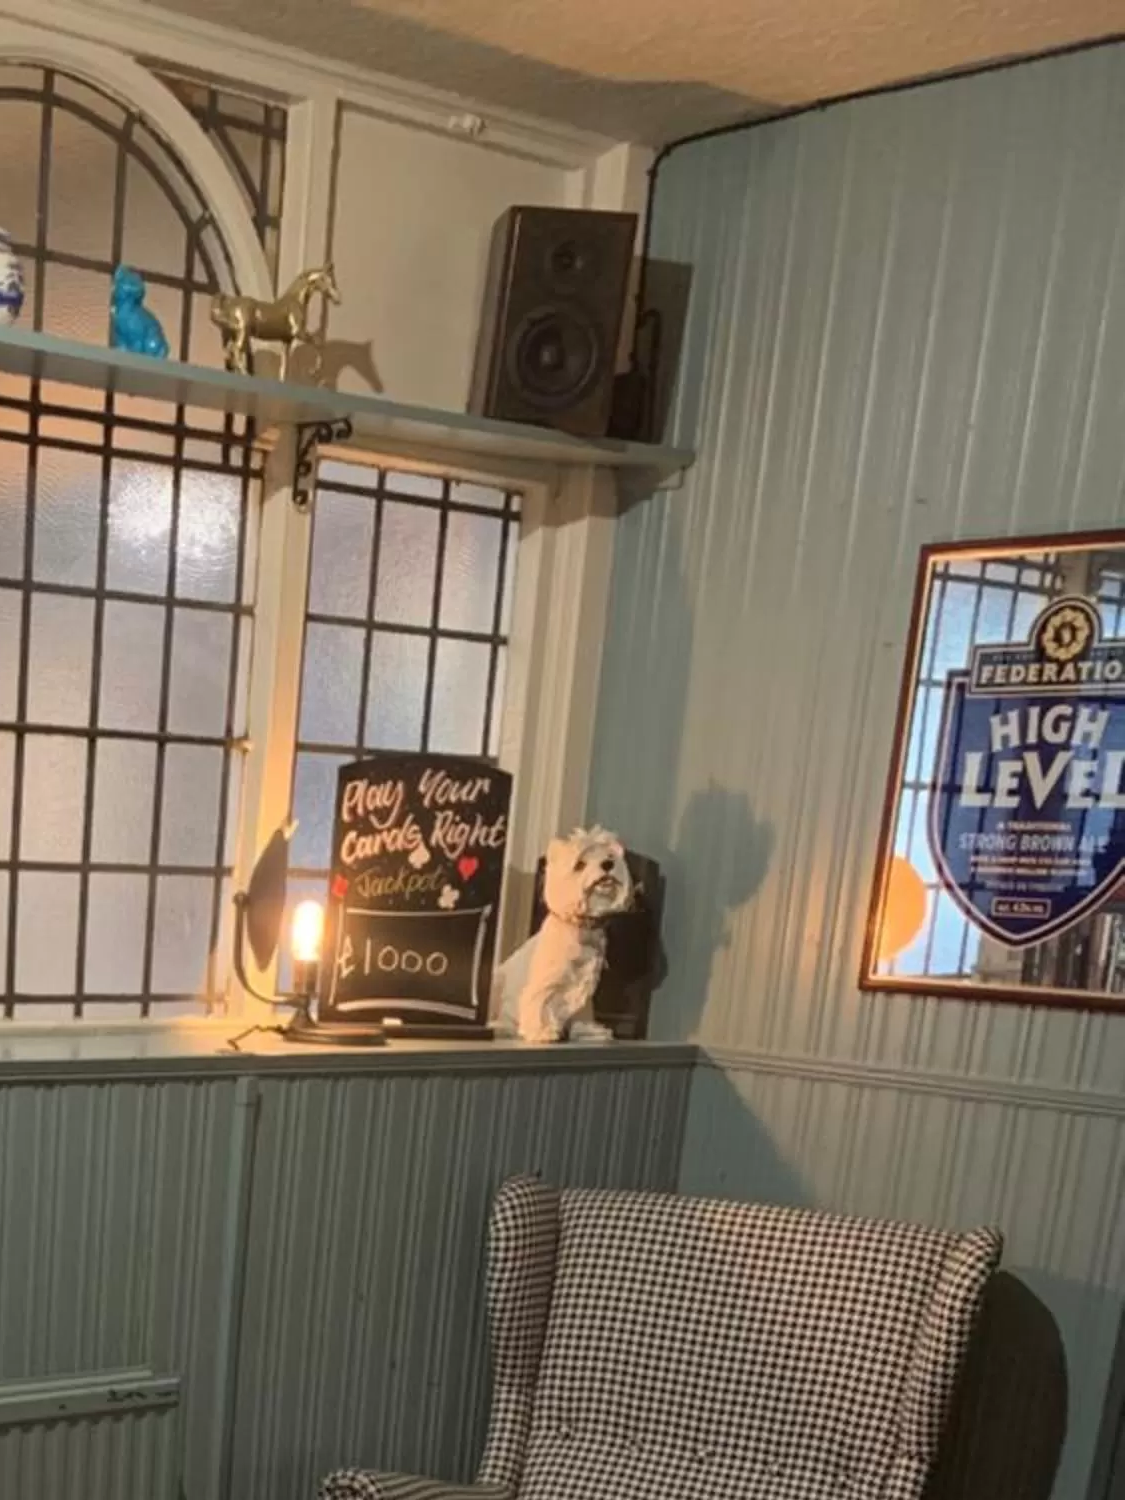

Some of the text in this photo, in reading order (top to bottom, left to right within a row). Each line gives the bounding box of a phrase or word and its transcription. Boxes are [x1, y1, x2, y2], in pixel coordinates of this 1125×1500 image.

[978, 659, 1125, 685] FEDERATIO
[989, 704, 1110, 752] HIGH
[342, 767, 492, 829] Play Your
[959, 749, 1125, 810] LEVEL
[340, 810, 506, 865] Cards Right
[958, 832, 1017, 850] STRONG
[1020, 834, 1075, 852] BROWN
[354, 865, 448, 901] Jackpot
